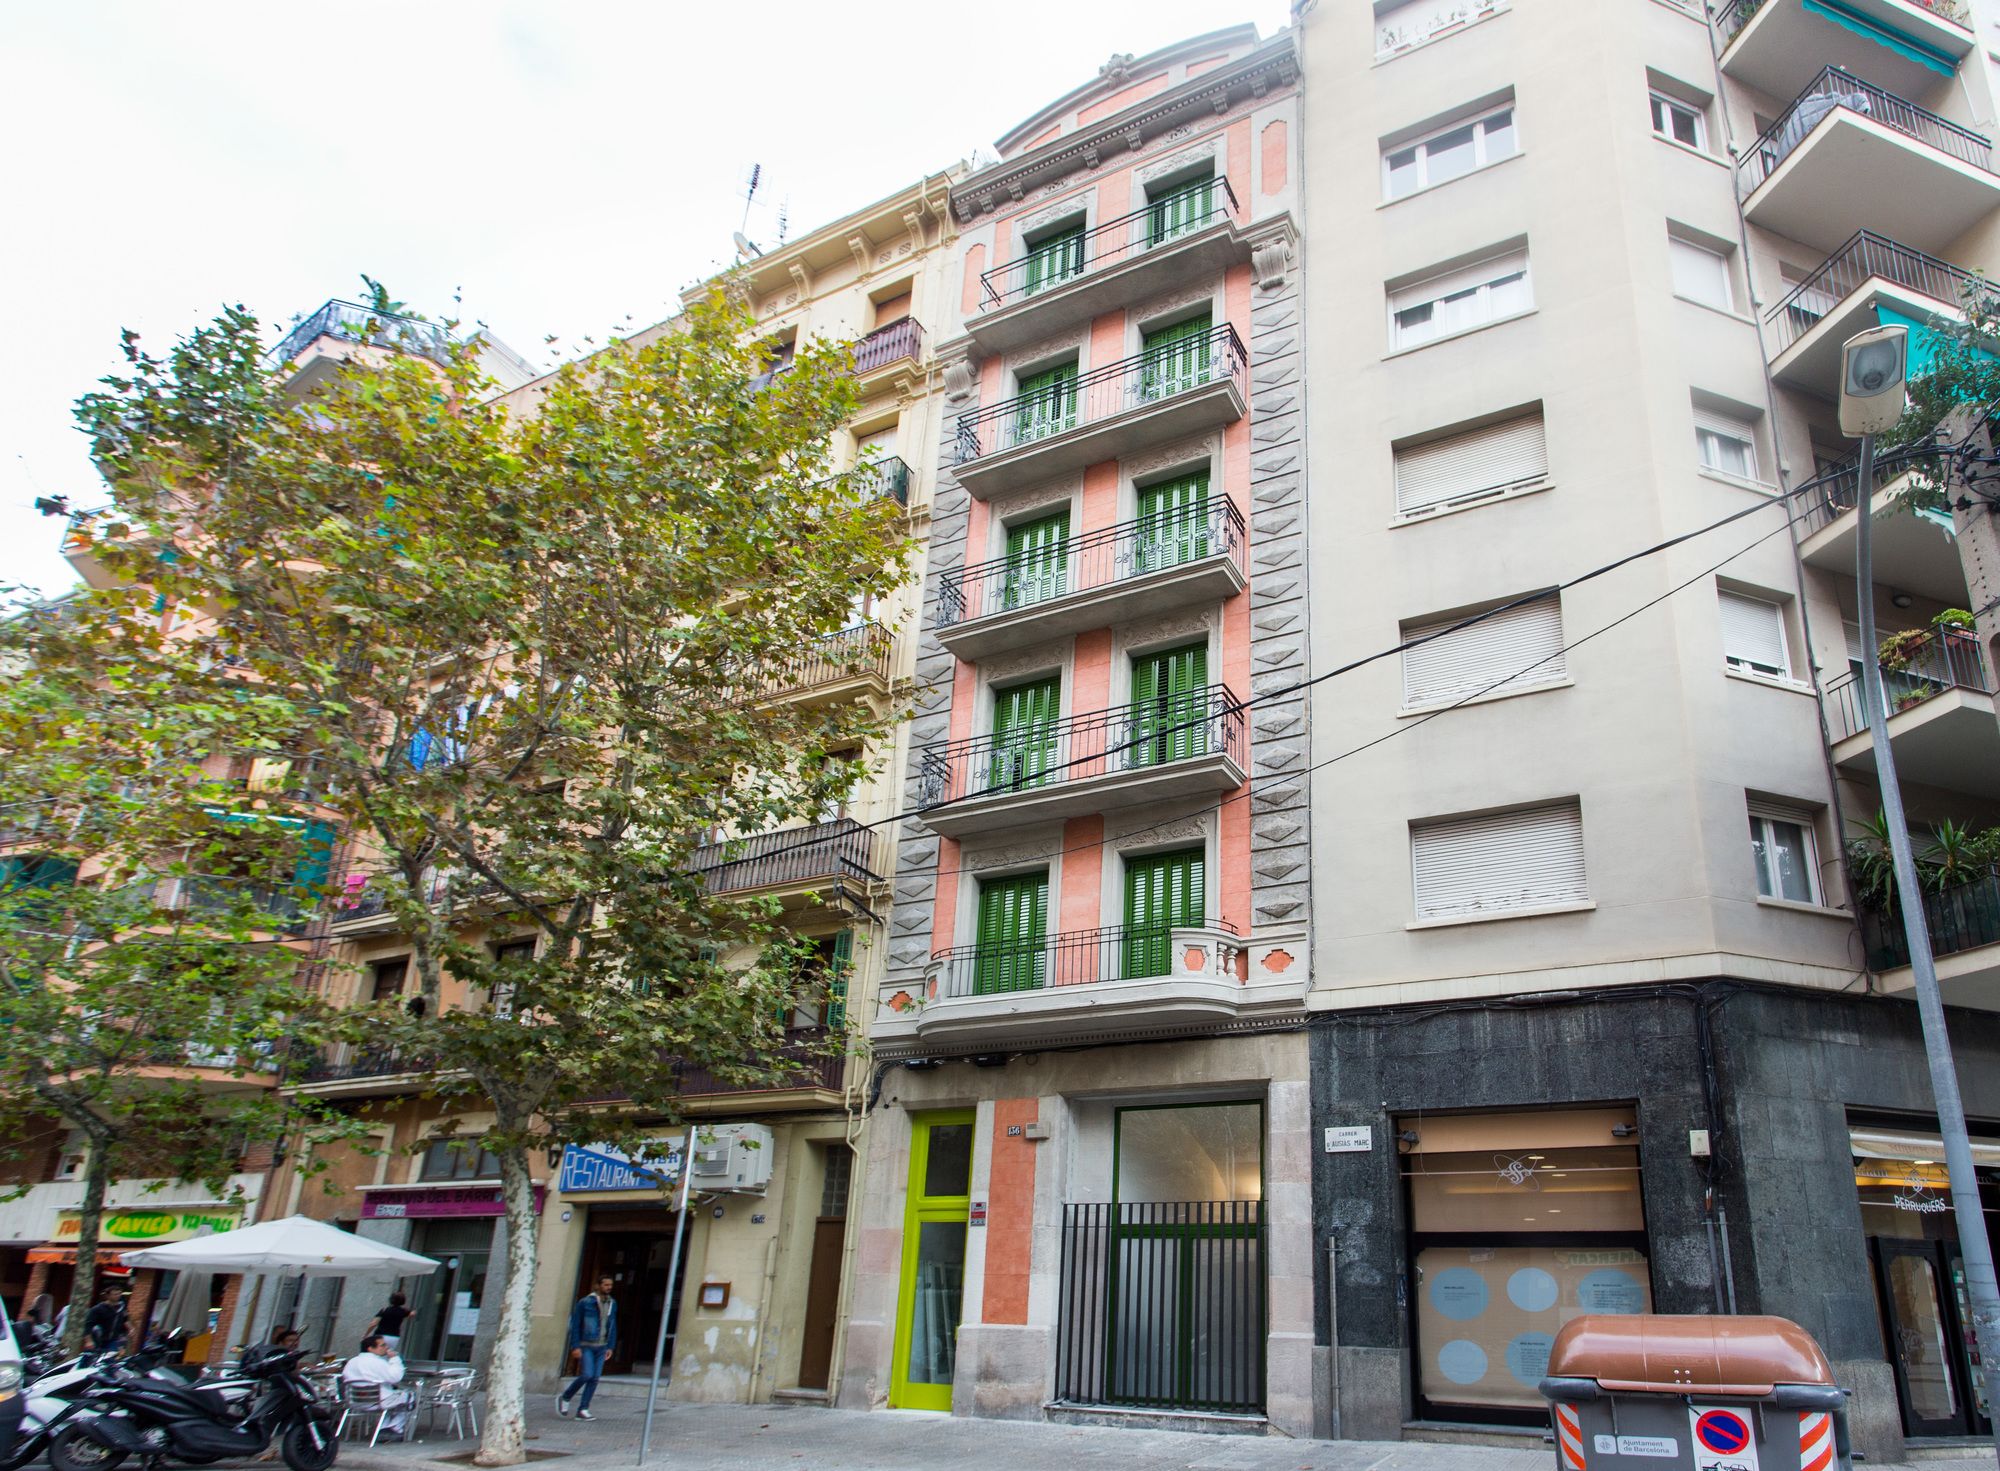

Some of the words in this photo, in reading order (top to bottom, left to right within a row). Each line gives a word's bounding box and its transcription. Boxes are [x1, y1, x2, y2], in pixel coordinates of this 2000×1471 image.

[561, 1151, 641, 1189] RESTAURANT
[1894, 1195, 1946, 1214] PERRUQUERS
[109, 1215, 174, 1234] JAVIER
[1633, 1446, 1670, 1454] Barcelona
